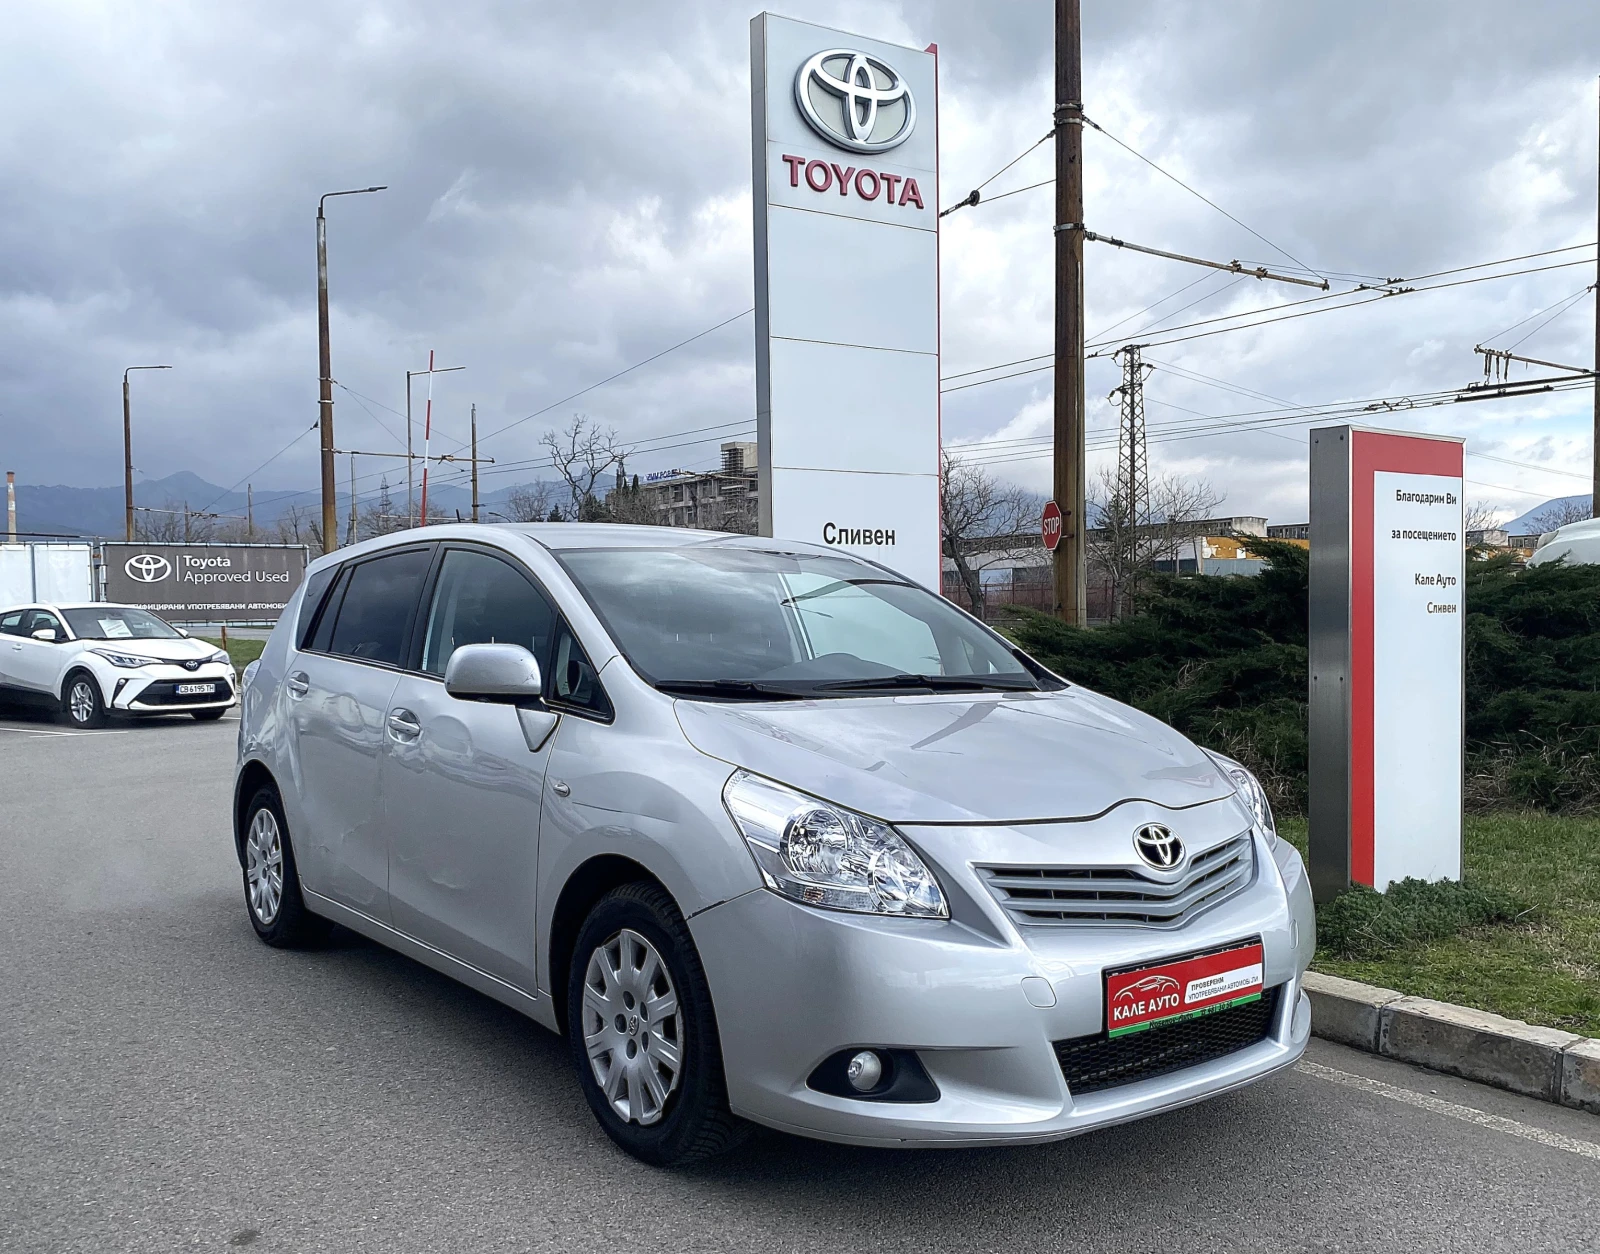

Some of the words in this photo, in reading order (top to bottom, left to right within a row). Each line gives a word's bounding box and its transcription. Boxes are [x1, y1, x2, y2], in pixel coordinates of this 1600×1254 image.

[782, 154, 924, 209] TOYOTA
[1395, 489, 1444, 506] Благодарим
[1446, 493, 1457, 505] Ви
[823, 522, 895, 545] Сливен
[1043, 516, 1060, 536] STOP
[1391, 530, 1401, 539] за
[1402, 530, 1457, 541] посещението
[183, 555, 231, 569] Toyota
[183, 571, 251, 584] Approved
[255, 571, 289, 582] Used
[1414, 573, 1435, 585] Кале
[1436, 574, 1457, 588] Ауто
[1426, 602, 1457, 614] Сливен
[1113, 1001, 1146, 1021] КАЛЕ
[1148, 993, 1180, 1013] АУТО
